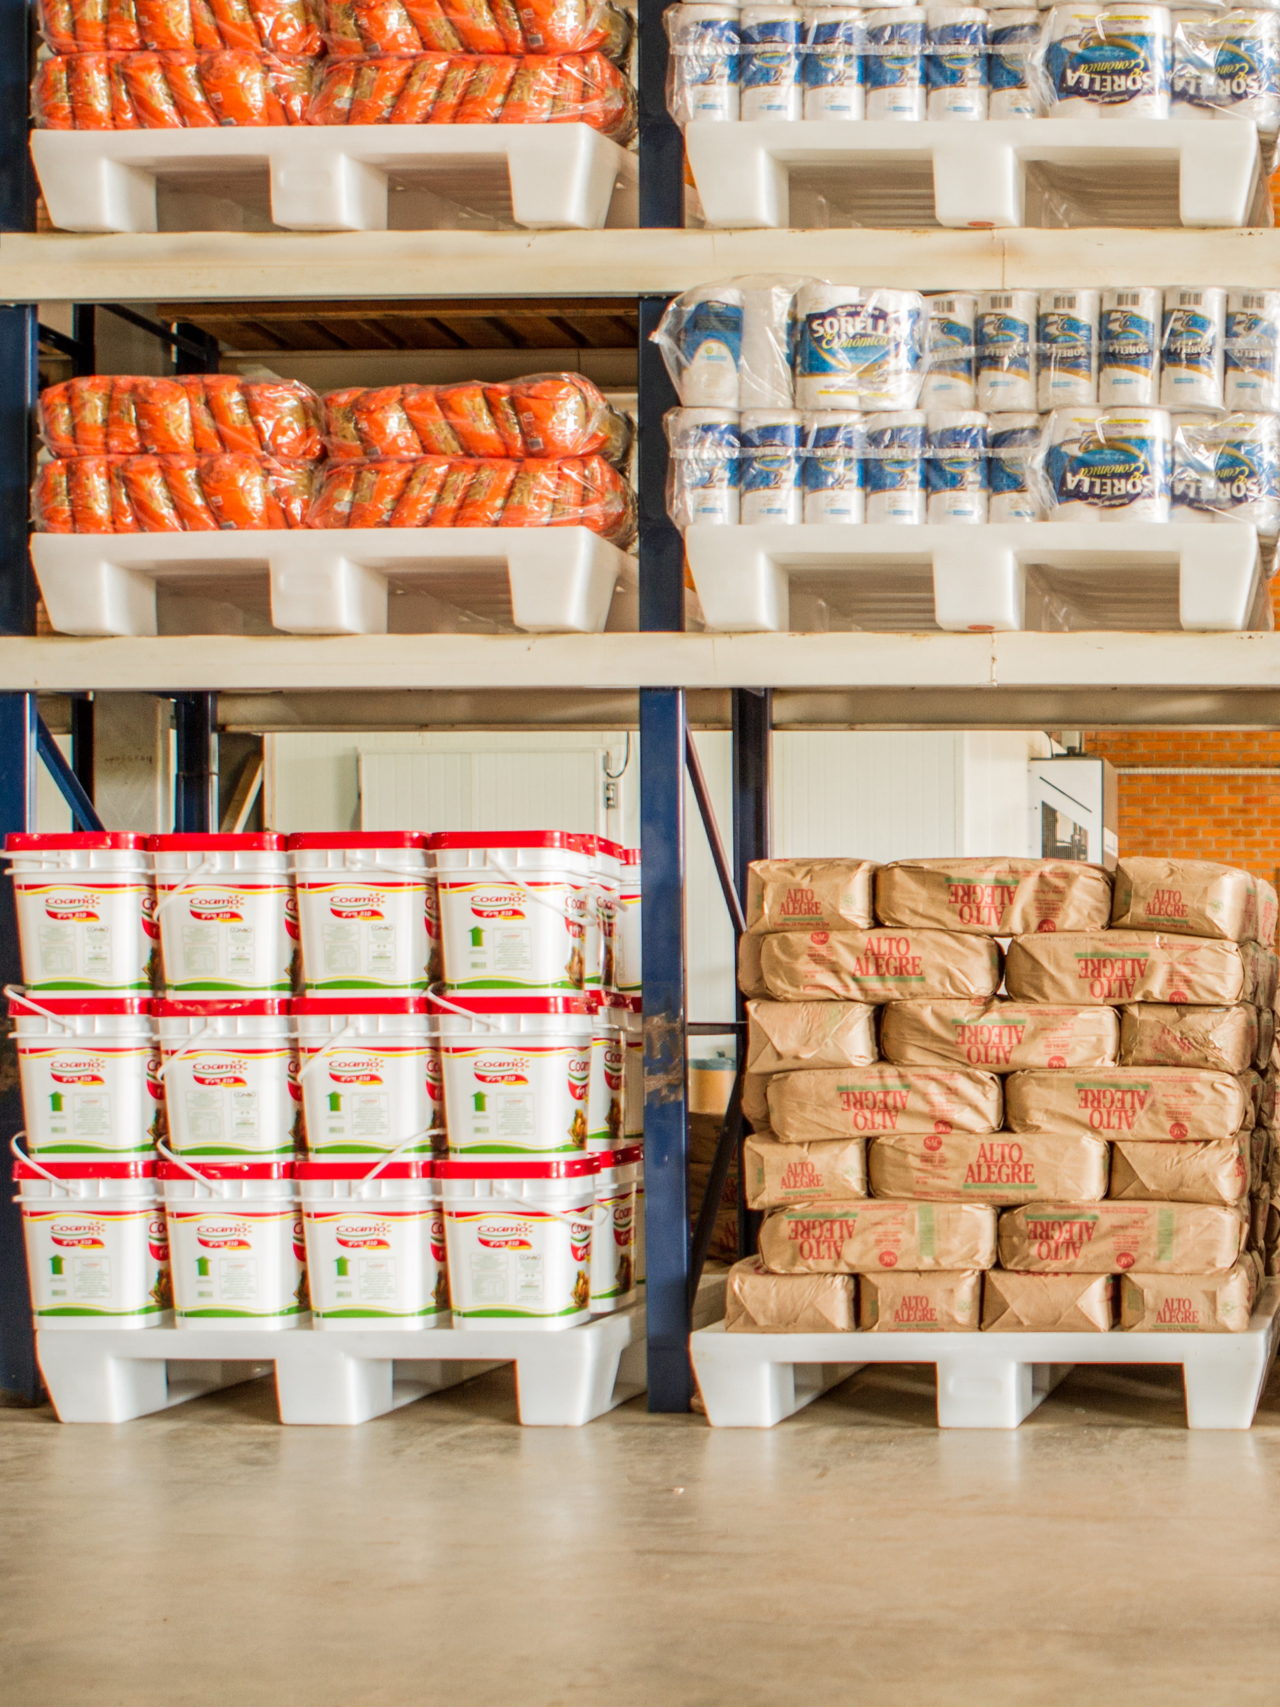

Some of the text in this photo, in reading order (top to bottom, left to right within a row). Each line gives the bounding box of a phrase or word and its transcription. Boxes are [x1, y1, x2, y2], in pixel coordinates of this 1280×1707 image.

[1066, 69, 1153, 92] SORELLA
[1066, 473, 1153, 496] SORELLA
[786, 889, 814, 901] ALTO
[949, 884, 1018, 904] ALEGRE
[1154, 889, 1182, 903] ALTO
[780, 902, 822, 915] ALEGRE
[959, 904, 1007, 926] ALTO
[1145, 903, 1188, 917] ALEGRE
[864, 937, 910, 956] ALTO
[852, 957, 922, 977] ALEGRE
[1078, 958, 1148, 978] ALEGRE
[1090, 978, 1135, 999] ALTO
[955, 1024, 1025, 1045] ALEGRE
[967, 1046, 1014, 1065] ALTO
[841, 1091, 910, 1111] ALEGRE
[1078, 1089, 1148, 1109] ALEGRE
[853, 1111, 898, 1130] ALTO
[1089, 1108, 1136, 1129] ALTO
[976, 1143, 1023, 1163] ALTO
[787, 1162, 815, 1175] ALTO
[964, 1163, 1035, 1184] ALEGRE
[780, 1174, 824, 1189] ALEGRE
[788, 1220, 856, 1240] ALEGRE
[1027, 1221, 1096, 1240] ALEGRE
[800, 1240, 843, 1260] ALTO
[1037, 1241, 1083, 1260] ALTO
[900, 1296, 928, 1309] ALTO
[1163, 1298, 1192, 1311] ALTO
[894, 1309, 938, 1322] ALEGRE
[1156, 1310, 1199, 1323] ALEGRE
